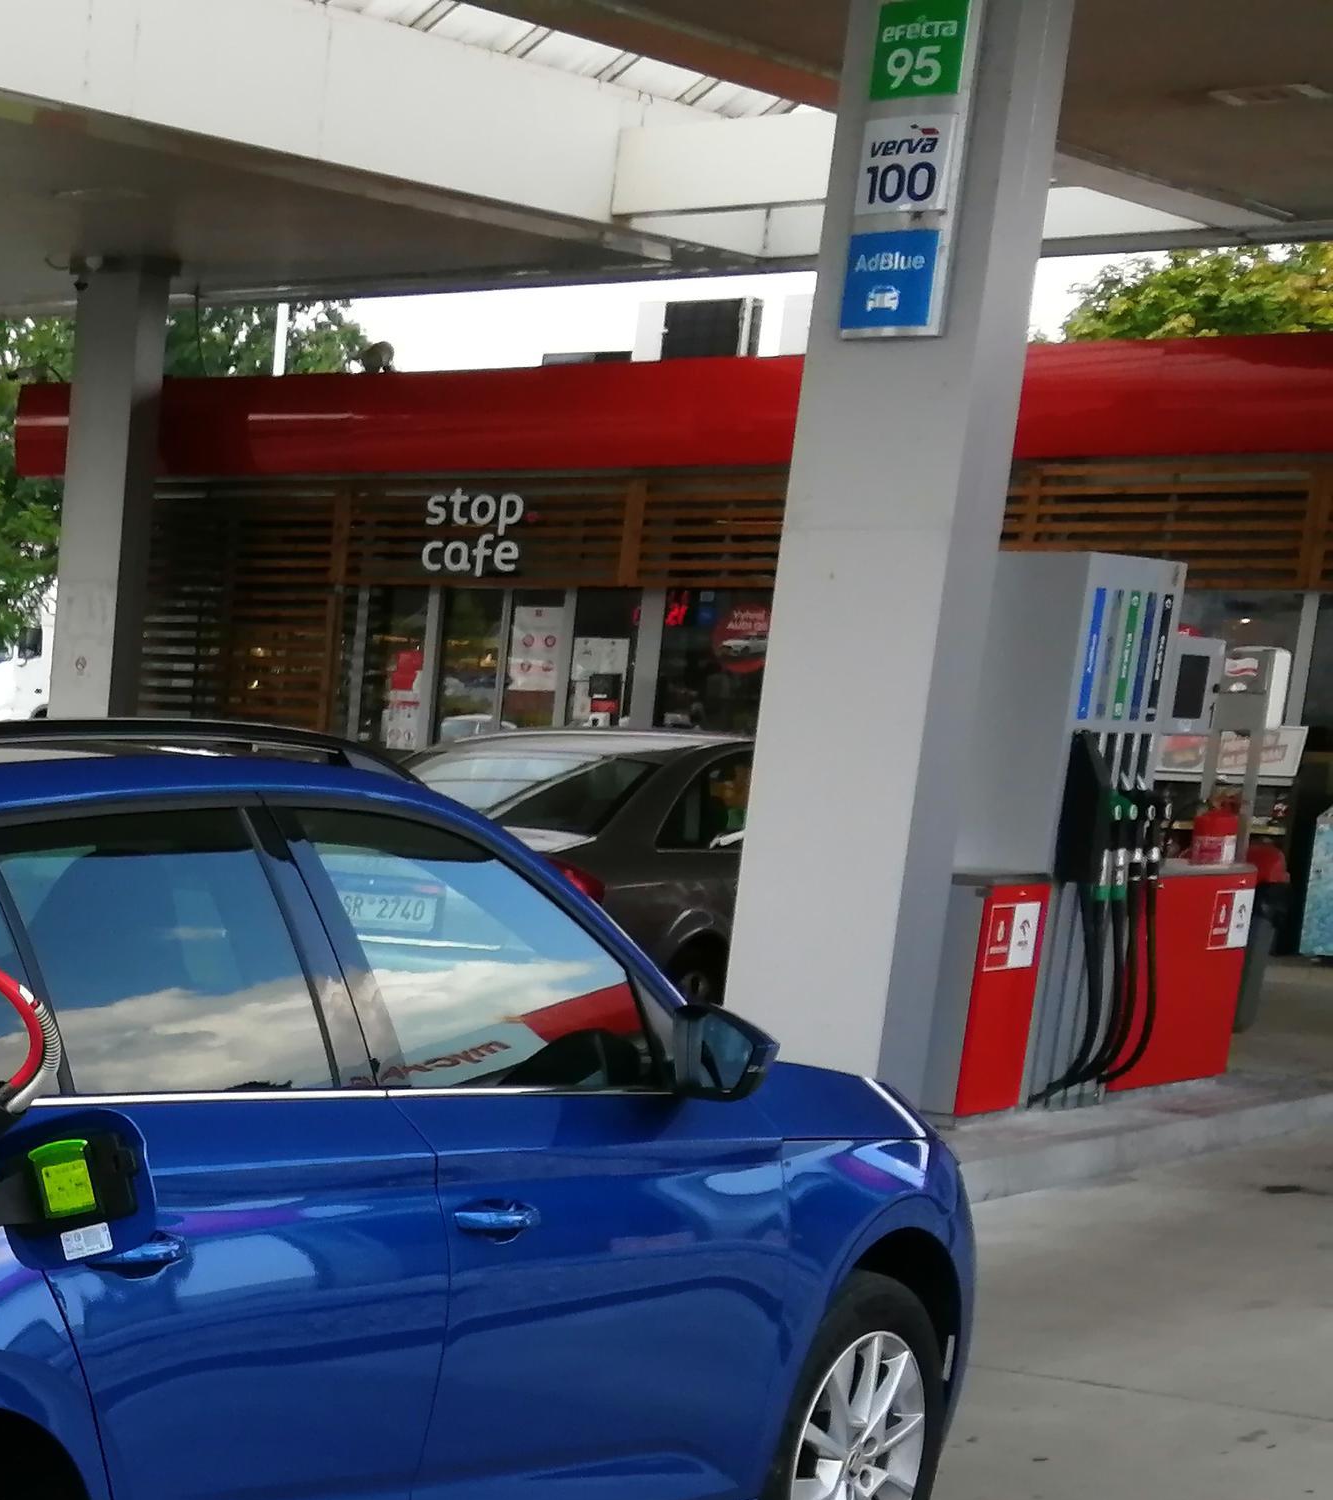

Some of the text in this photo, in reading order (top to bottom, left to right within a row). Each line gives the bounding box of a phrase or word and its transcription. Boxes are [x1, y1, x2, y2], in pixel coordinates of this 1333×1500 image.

[886, 45, 941, 90] 95
[870, 136, 939, 158] verva
[866, 161, 936, 205] 100
[854, 251, 925, 273] AdBlue
[422, 533, 519, 577] cafe
